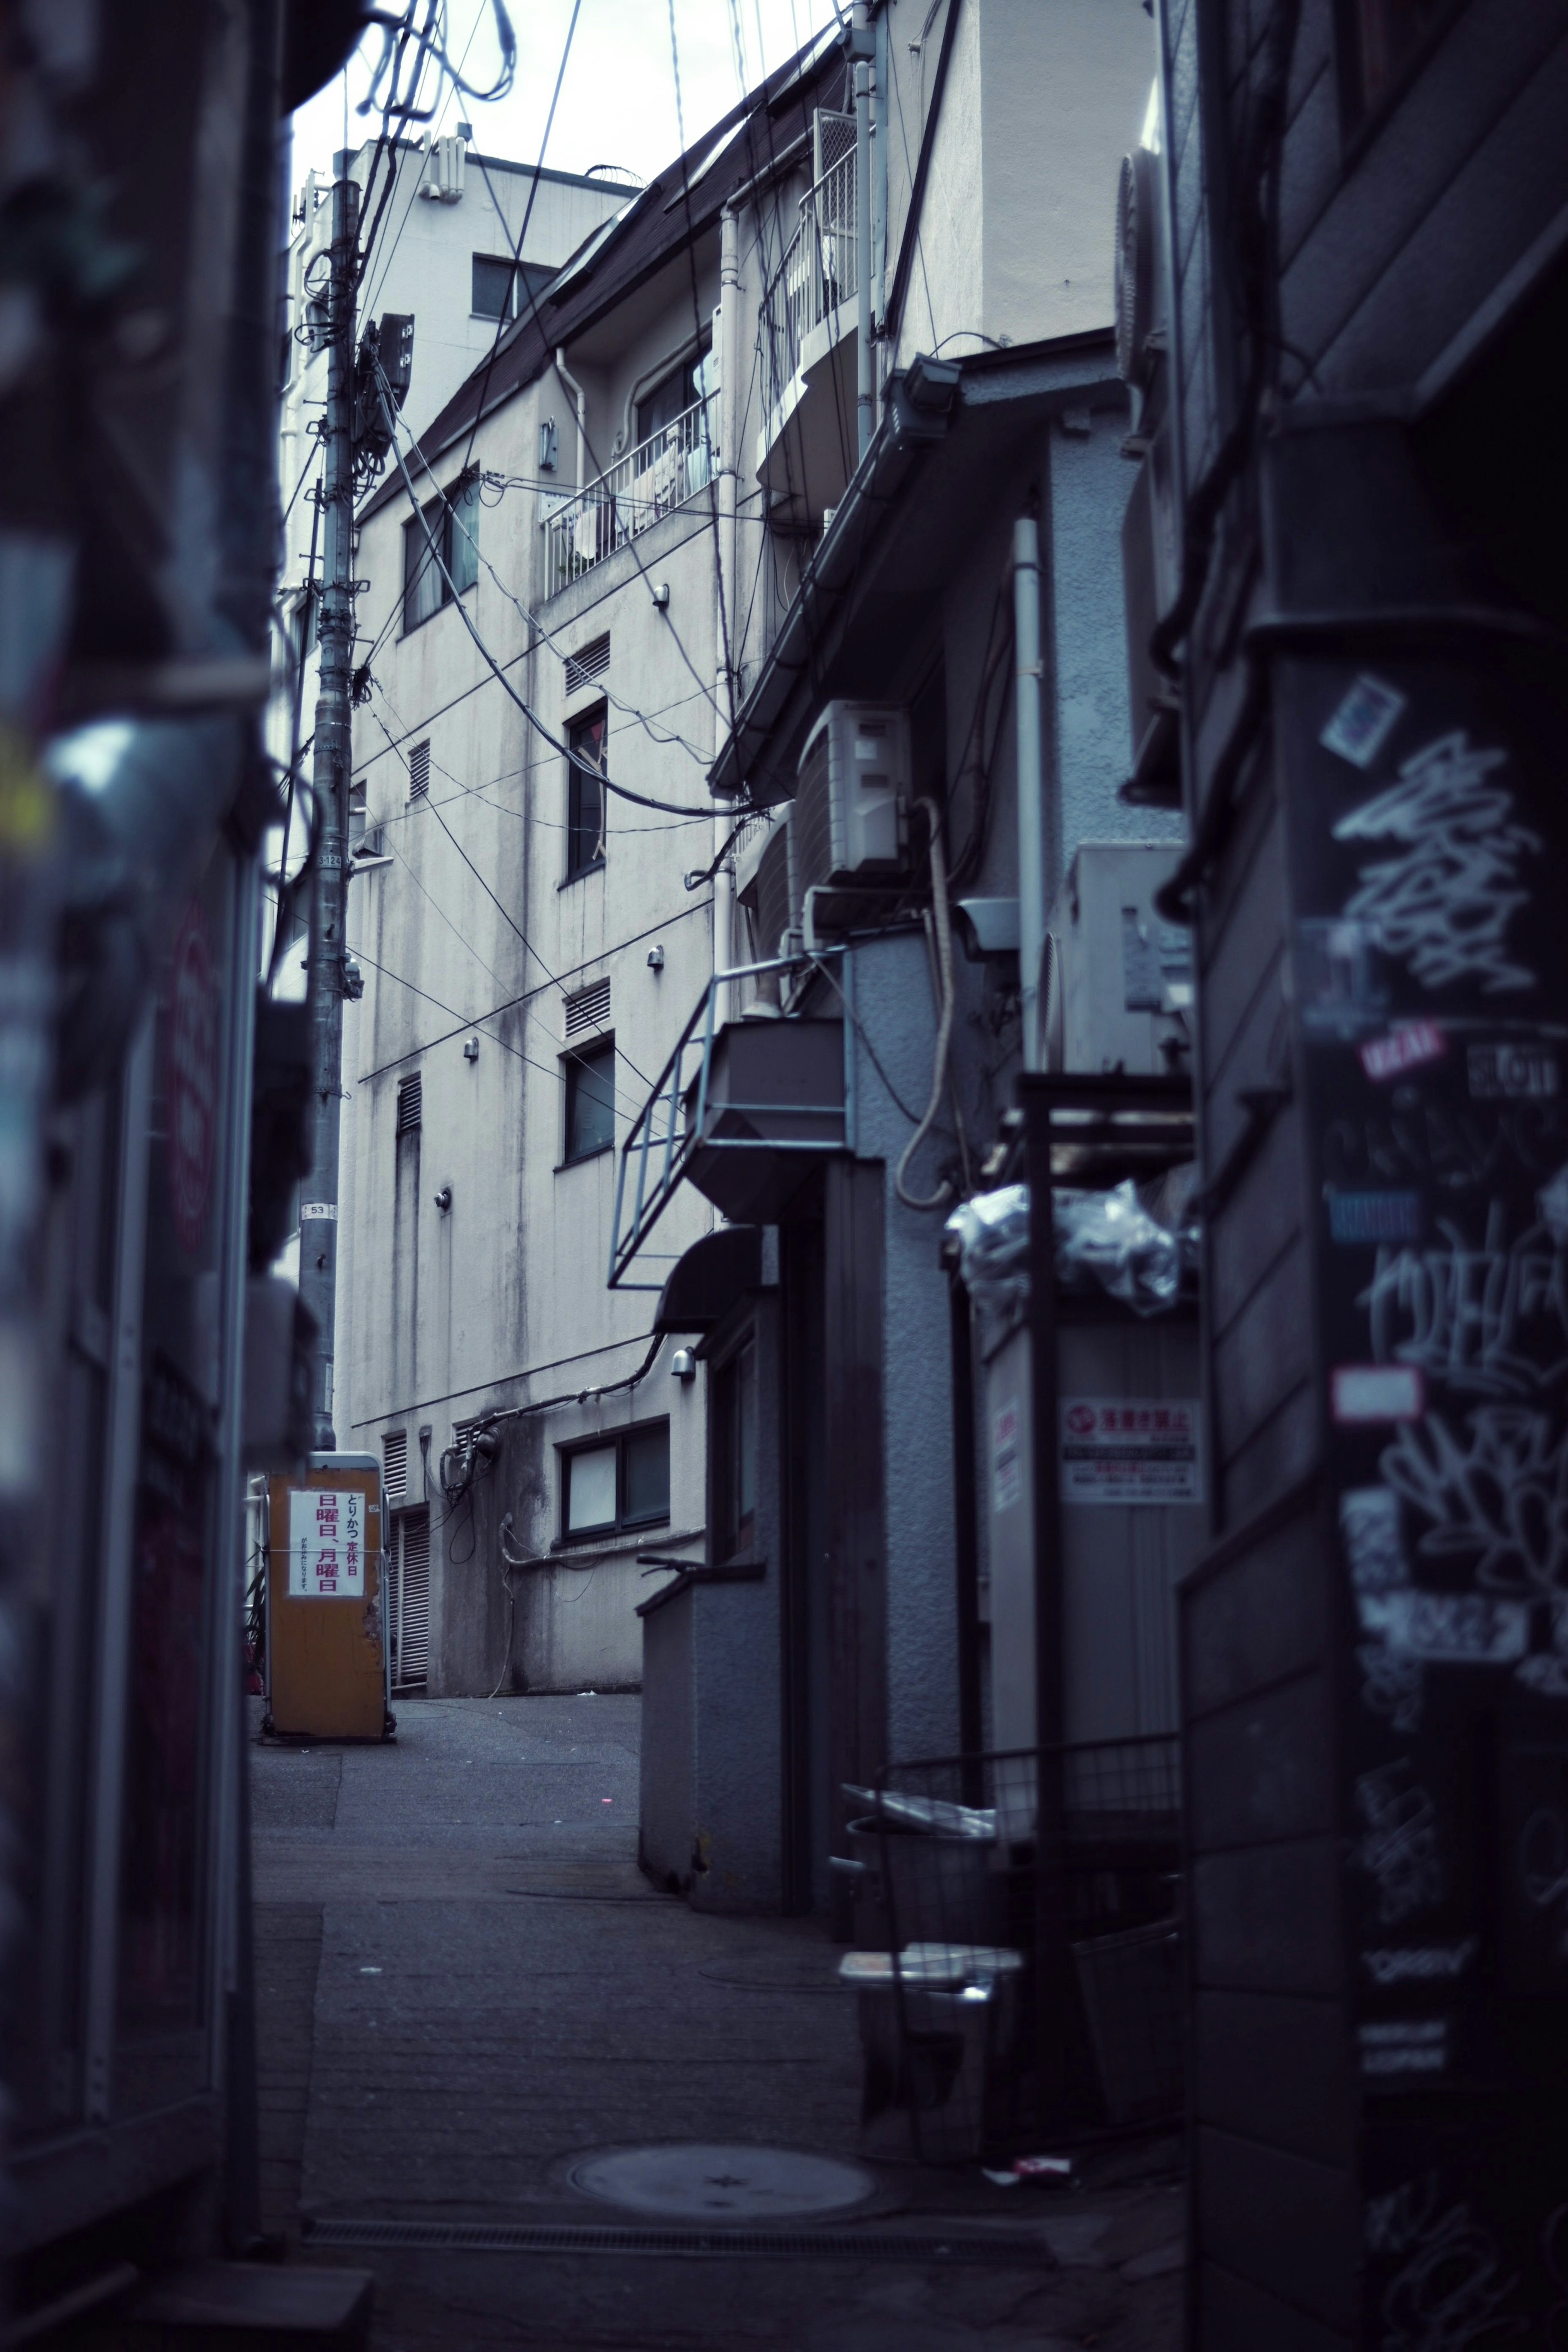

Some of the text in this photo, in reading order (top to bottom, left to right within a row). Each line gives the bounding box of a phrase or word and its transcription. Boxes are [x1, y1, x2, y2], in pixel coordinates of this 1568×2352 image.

[318, 856, 340, 865] 3-124
[316, 1494, 340, 1592] 日曜日、月曜日
